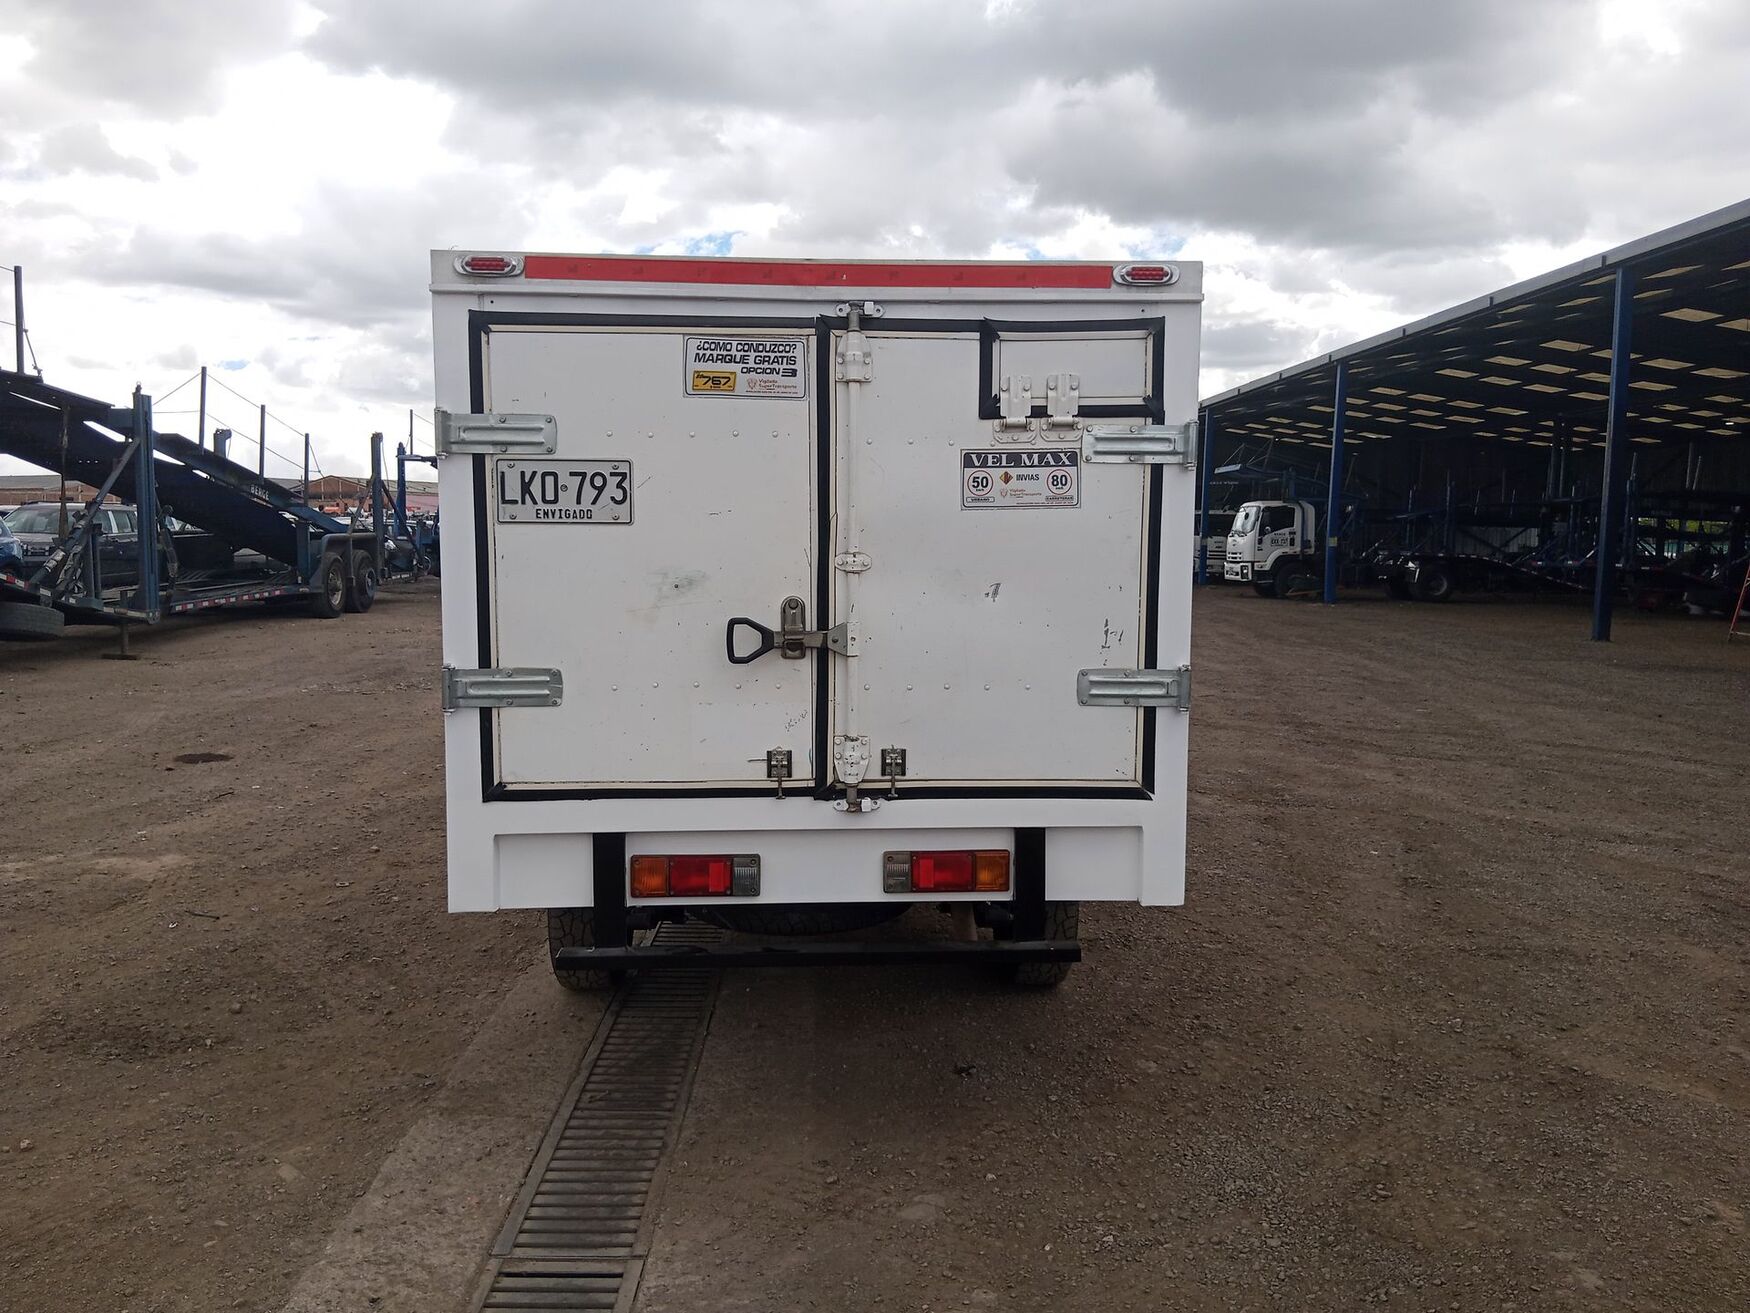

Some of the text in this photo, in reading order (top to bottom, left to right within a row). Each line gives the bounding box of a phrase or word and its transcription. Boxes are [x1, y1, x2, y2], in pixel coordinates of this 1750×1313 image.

[697, 341, 797, 354] ¿COMO CONDUZCO?
[693, 353, 797, 366] MARQUE GRATIS
[741, 367, 798, 378] OPCION 3
[969, 452, 1072, 467] VEL MAX
[972, 476, 989, 489] 50
[1016, 474, 1040, 482] INVIAS
[1051, 474, 1068, 487] 80
[500, 470, 628, 505] LKO 793
[536, 508, 593, 520] ENVIGADO
